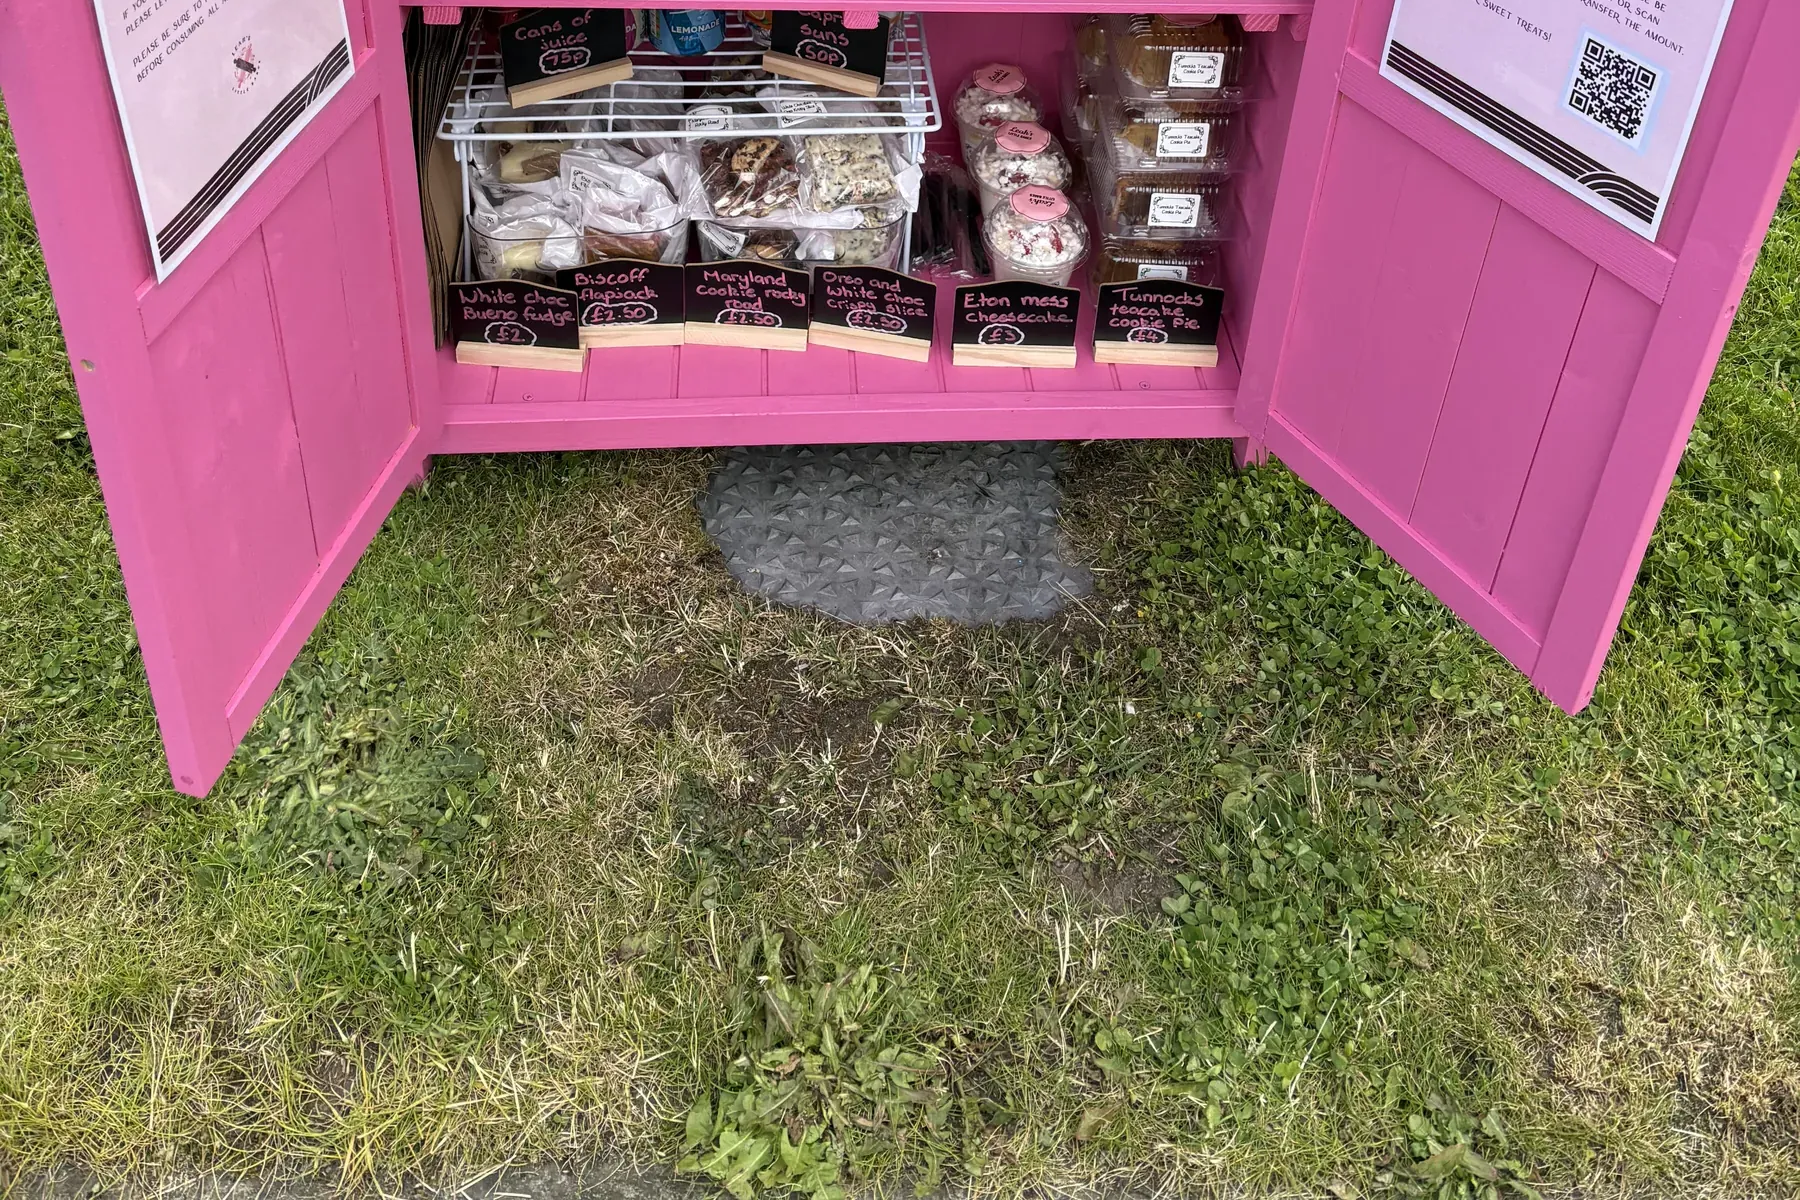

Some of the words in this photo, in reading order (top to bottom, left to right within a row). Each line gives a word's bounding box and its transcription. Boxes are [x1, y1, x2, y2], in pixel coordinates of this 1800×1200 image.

[1654, 0, 1666, 12] BE
[514, 20, 562, 42] Cans
[572, 9, 593, 27] of
[671, 18, 720, 34] LEMONADE
[798, 11, 842, 26] apr
[132, 37, 159, 67] PLEASE
[160, 27, 170, 41] BE
[172, 9, 190, 30] SURE
[192, 0, 202, 12] TO
[1516, 16, 1551, 42] TREATS!
[540, 30, 588, 50] juice
[547, 50, 583, 66] 75p
[805, 46, 839, 64] 50p
[1010, 127, 1033, 136] Leah's
[1028, 198, 1055, 207] Leah's
[575, 269, 649, 285] Biscoff
[704, 270, 787, 291] Maryland
[822, 271, 863, 286] Oreo
[870, 279, 901, 292] and
[460, 288, 516, 305] White
[524, 290, 569, 307] choc
[578, 285, 658, 301] flapjack
[764, 286, 806, 307] rocky
[885, 292, 925, 306] choc
[964, 292, 1010, 308] Eton
[1020, 292, 1068, 307] mess
[1112, 286, 1204, 306] Tunnocks
[725, 297, 763, 310] road
[885, 303, 928, 317] slice
[1109, 304, 1184, 317] teacake
[464, 305, 518, 321] Bueno
[523, 307, 575, 327] fudge
[591, 307, 646, 322] £2.50
[728, 312, 775, 325] £2.50
[851, 313, 902, 331] £2.50
[966, 310, 1073, 324] cheesecake
[1109, 317, 1166, 329] cookie
[496, 328, 525, 342] £2
[989, 329, 1016, 341] £3
[1134, 330, 1158, 342] £4
